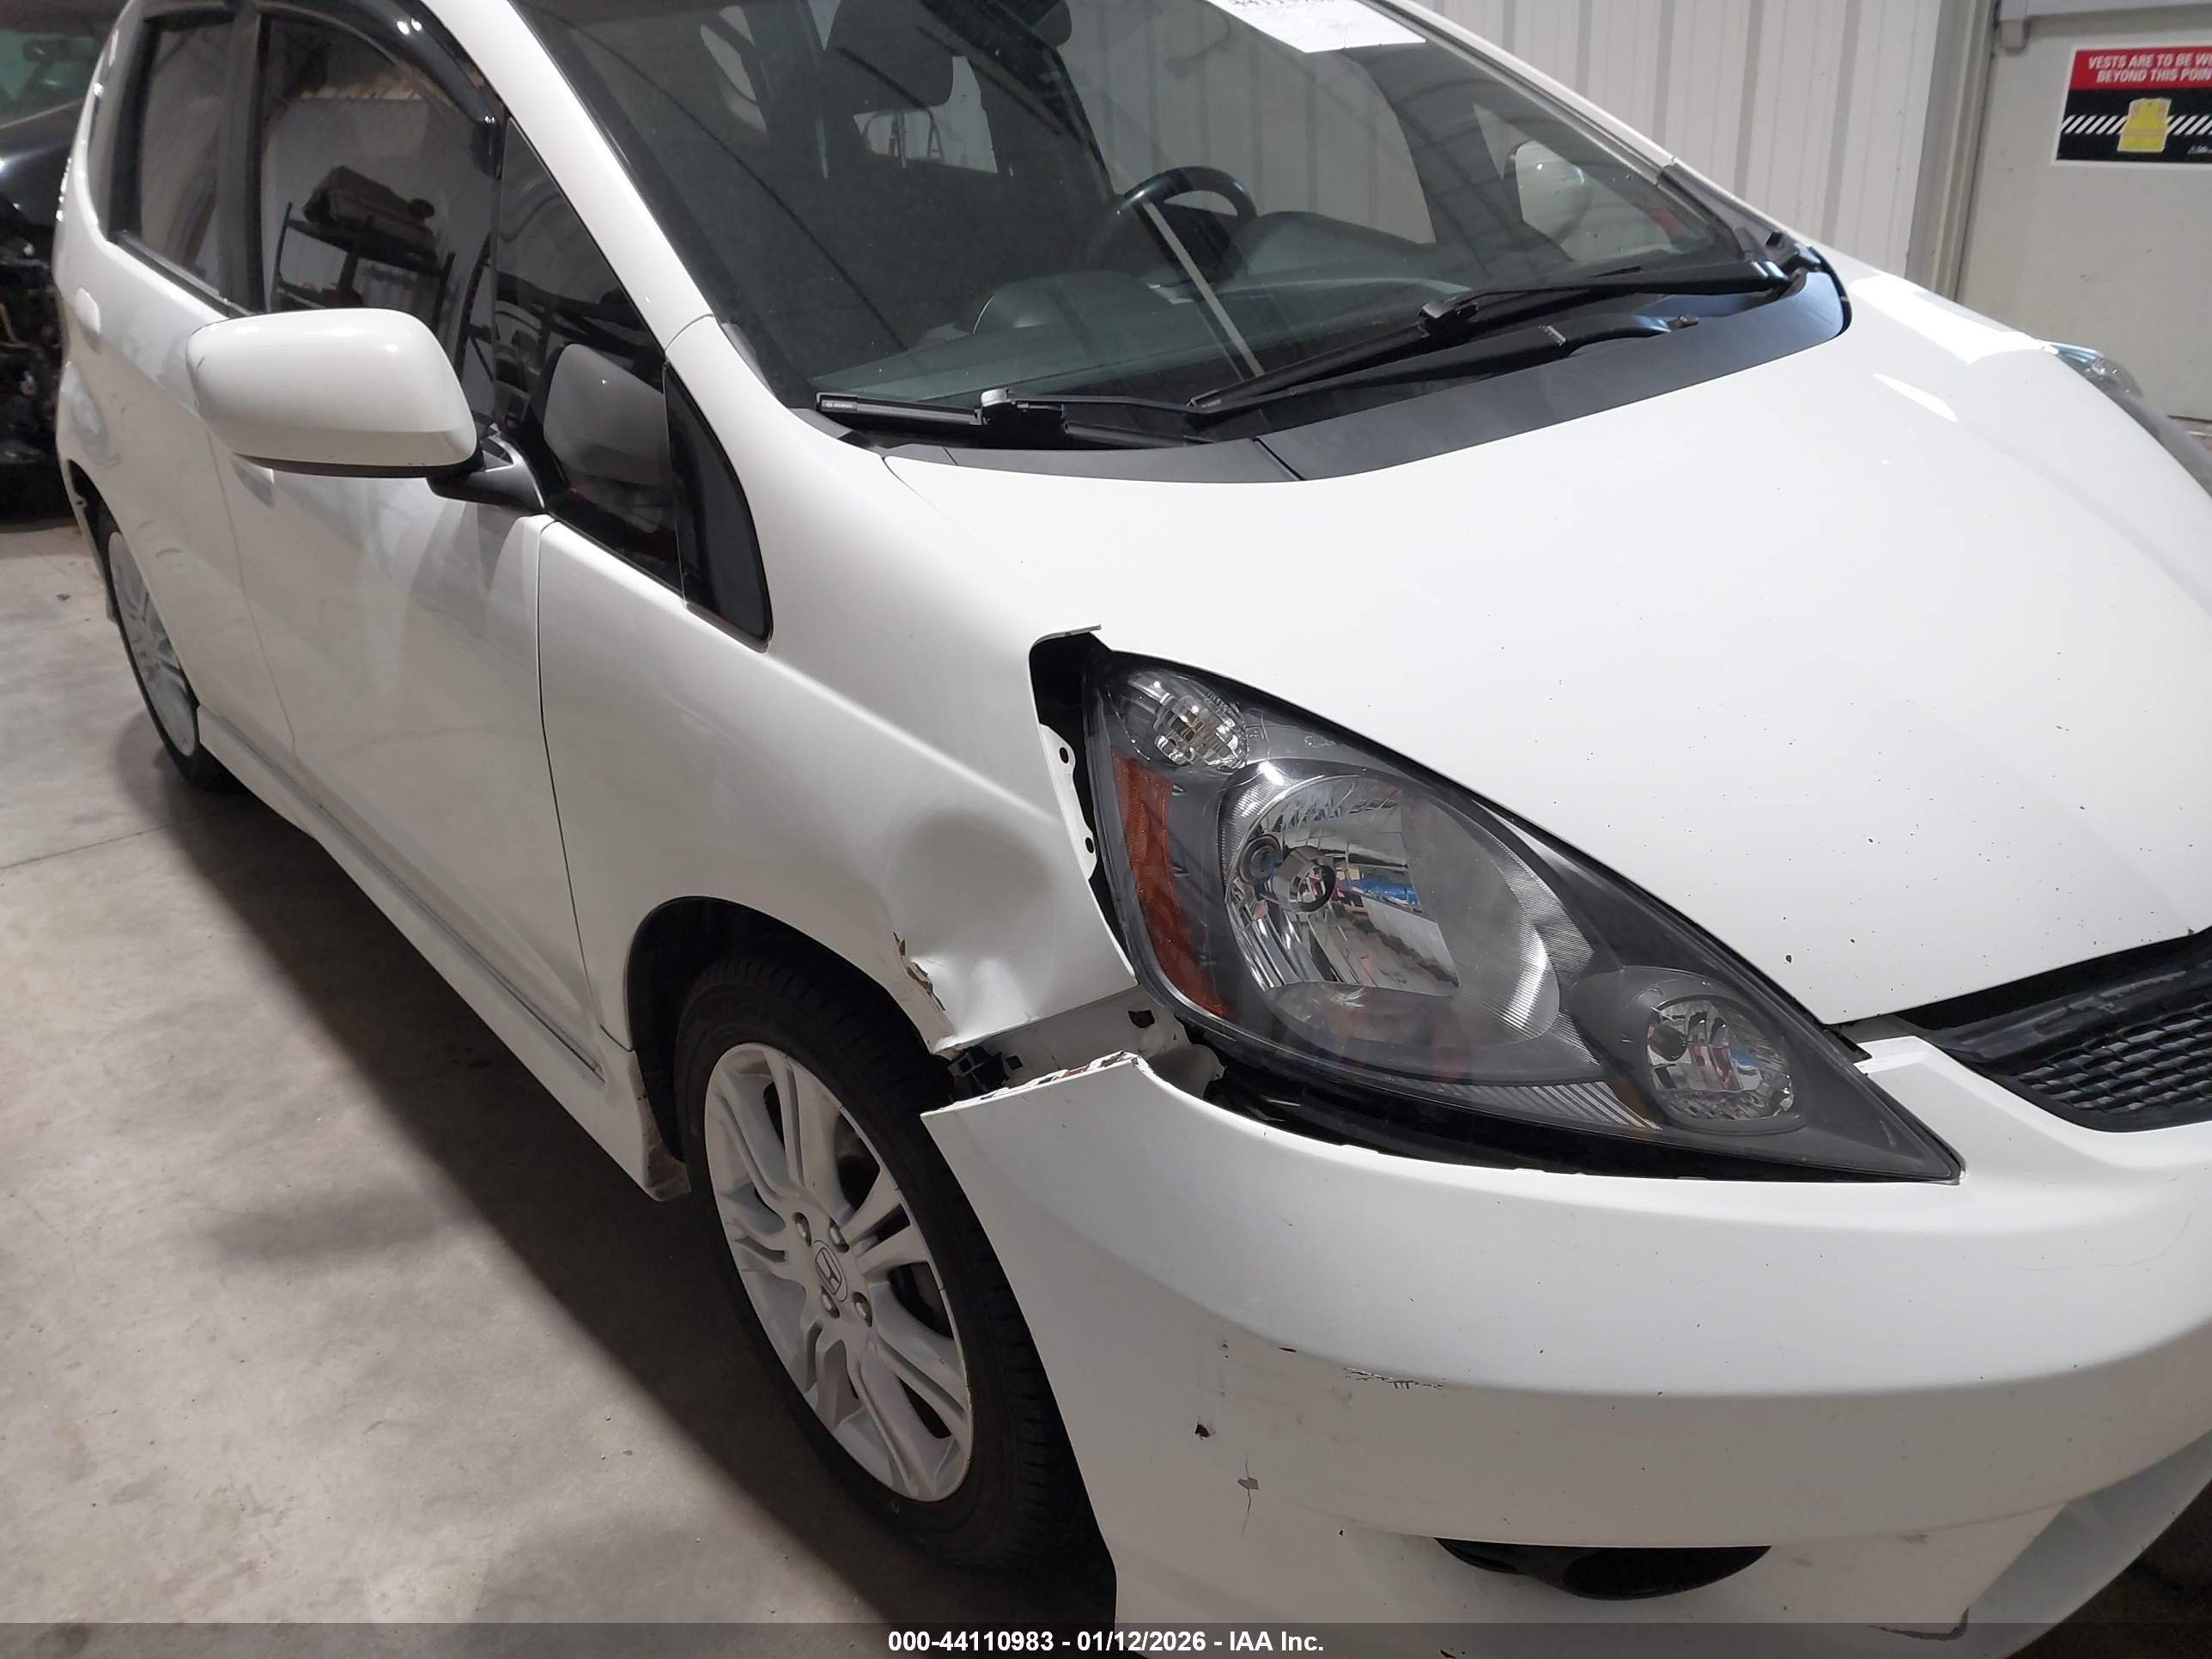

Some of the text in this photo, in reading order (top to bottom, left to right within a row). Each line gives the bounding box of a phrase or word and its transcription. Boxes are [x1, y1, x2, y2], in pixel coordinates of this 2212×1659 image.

[2088, 54, 2127, 69] VESTS
[2128, 54, 2154, 68] ARE
[2157, 53, 2174, 67] TO
[2176, 53, 2193, 67] BE
[2096, 69, 2148, 82] BEYOND
[2150, 69, 2179, 82] THIS
